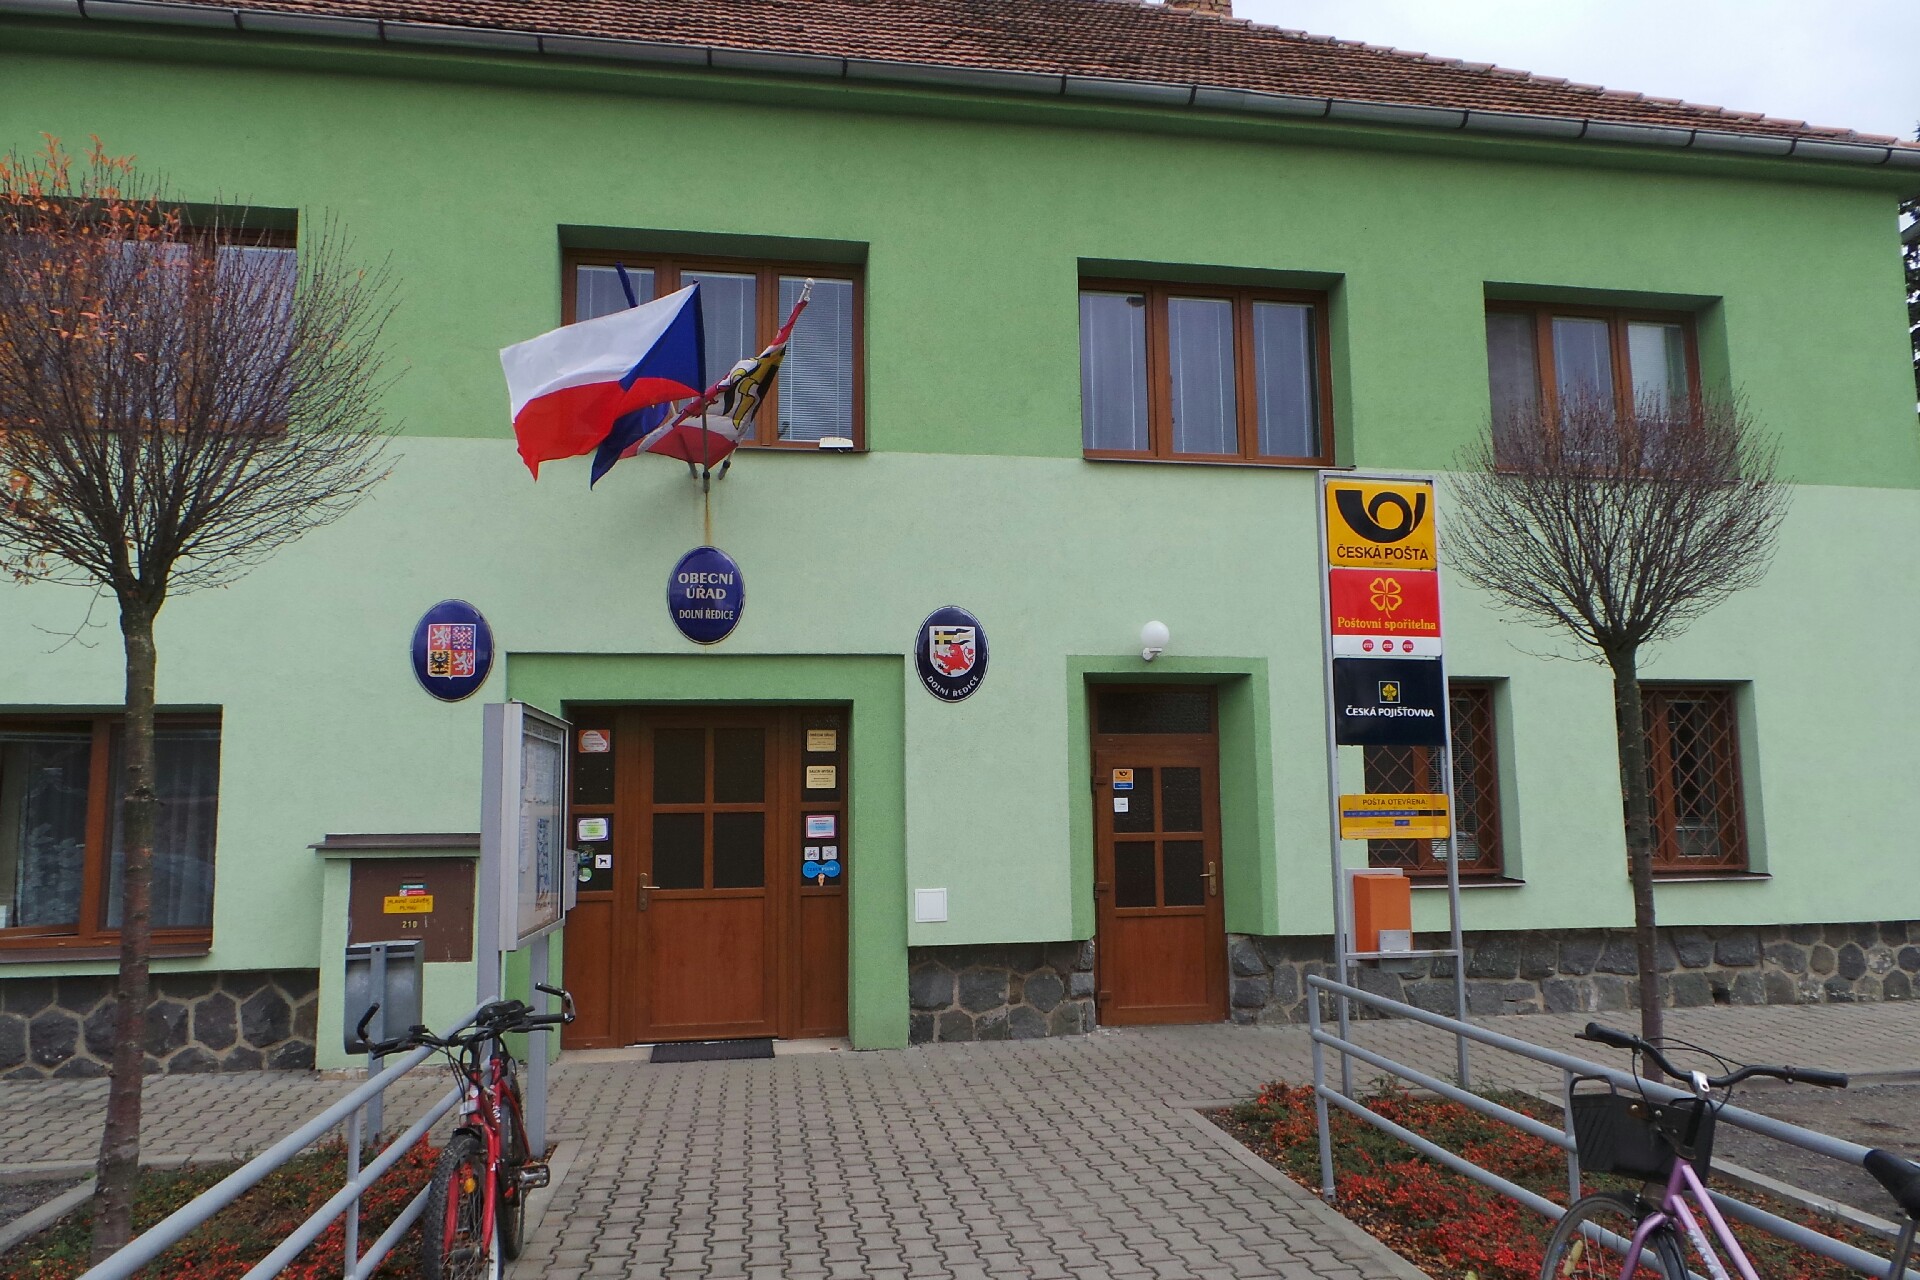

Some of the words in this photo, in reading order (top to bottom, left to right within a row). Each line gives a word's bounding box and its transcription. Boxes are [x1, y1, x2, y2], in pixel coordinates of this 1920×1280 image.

[1336, 543, 1382, 559] ČESKÁ
[1385, 546, 1429, 561] POŠTA
[678, 571, 734, 585] OBECNÍ
[687, 584, 727, 599] ÚŘAD
[679, 607, 703, 619] DOLNÍ
[705, 608, 734, 620] ŘEDICE
[1337, 616, 1382, 629] Poštovní
[1385, 618, 1436, 631] spořitelna
[926, 675, 949, 696] DOLNÍ
[952, 675, 979, 697] ŘEDICE
[1345, 704, 1377, 717] ČESKÁ
[1378, 705, 1435, 718] POJIŠŤOVNA
[1362, 798, 1386, 806] POŠTA
